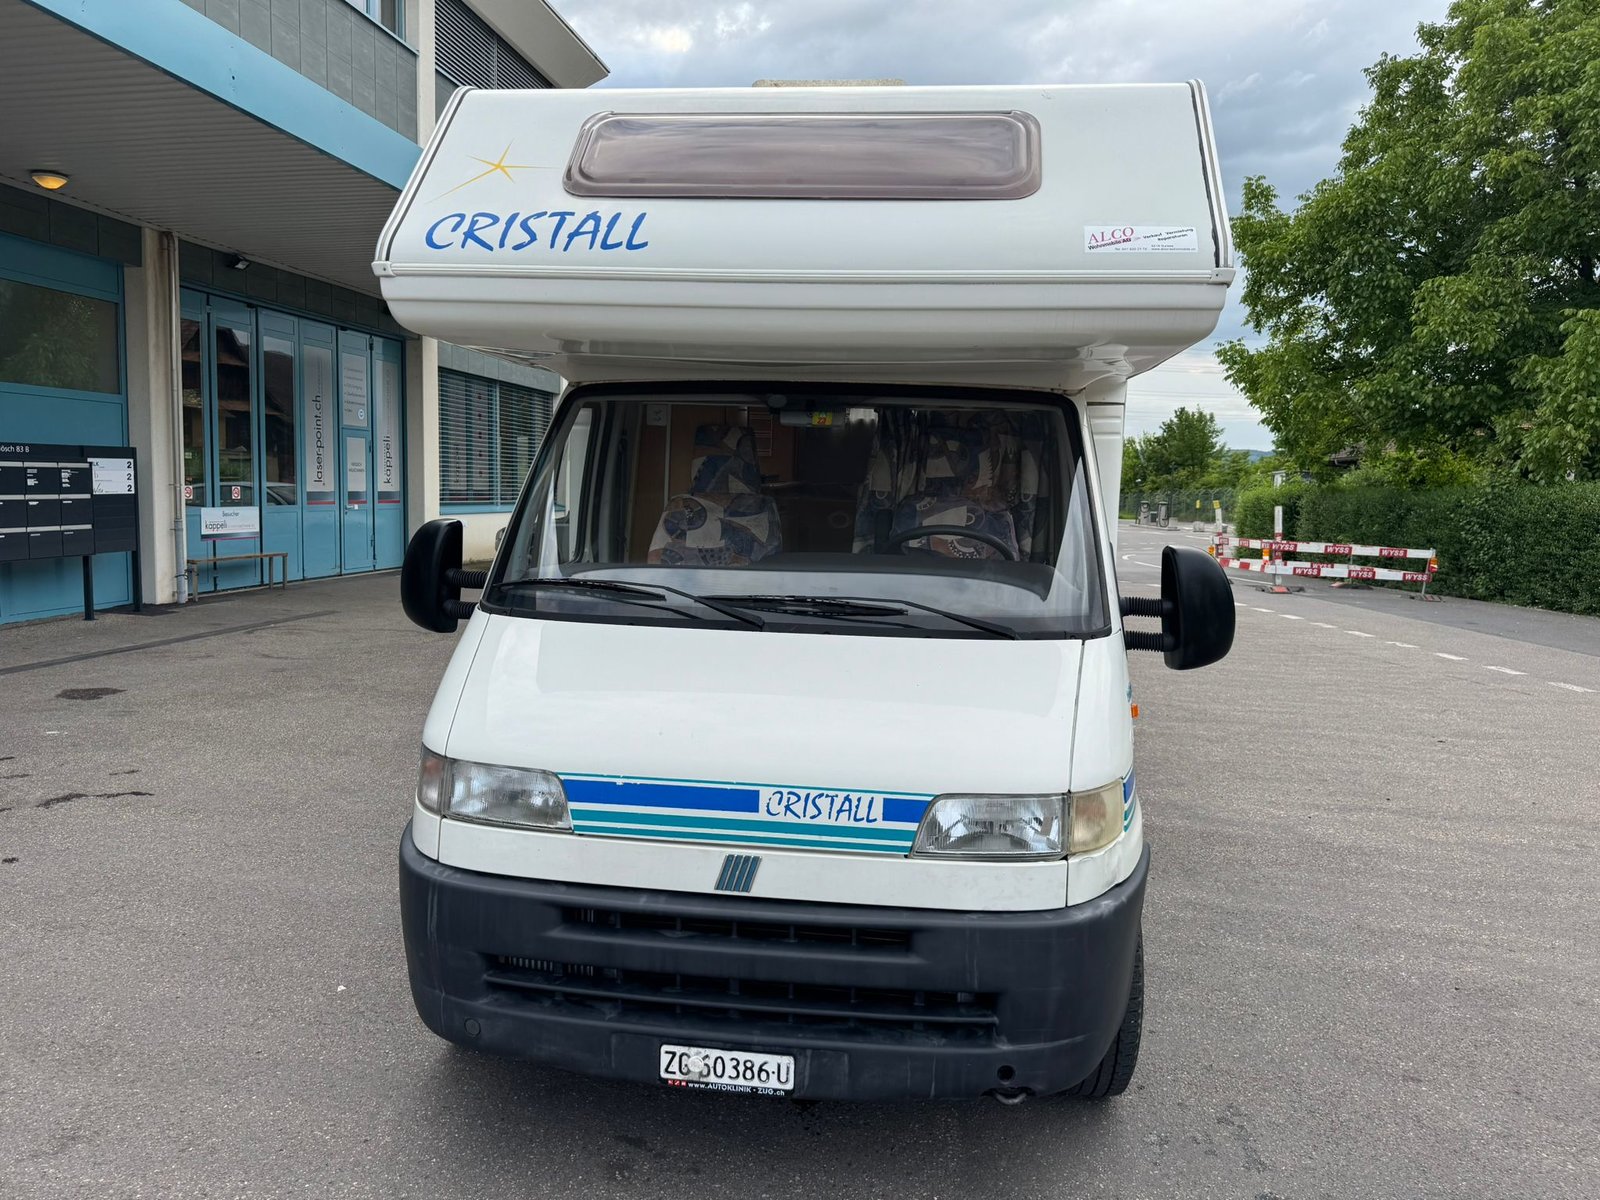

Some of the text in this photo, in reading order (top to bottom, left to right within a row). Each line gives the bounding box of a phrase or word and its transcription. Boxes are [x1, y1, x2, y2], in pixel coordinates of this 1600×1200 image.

[425, 211, 649, 252] CRISTALL
[1088, 227, 1134, 244] ALCO
[312, 395, 324, 483] laser-point.ch
[126, 461, 132, 469] 2
[1272, 543, 1296, 551] WYSS
[1326, 546, 1350, 554] WYSS
[1381, 549, 1405, 557] WYSS
[1295, 568, 1319, 576] WYSS
[1405, 573, 1428, 581] WYSS
[765, 790, 878, 824] CRISTALL
